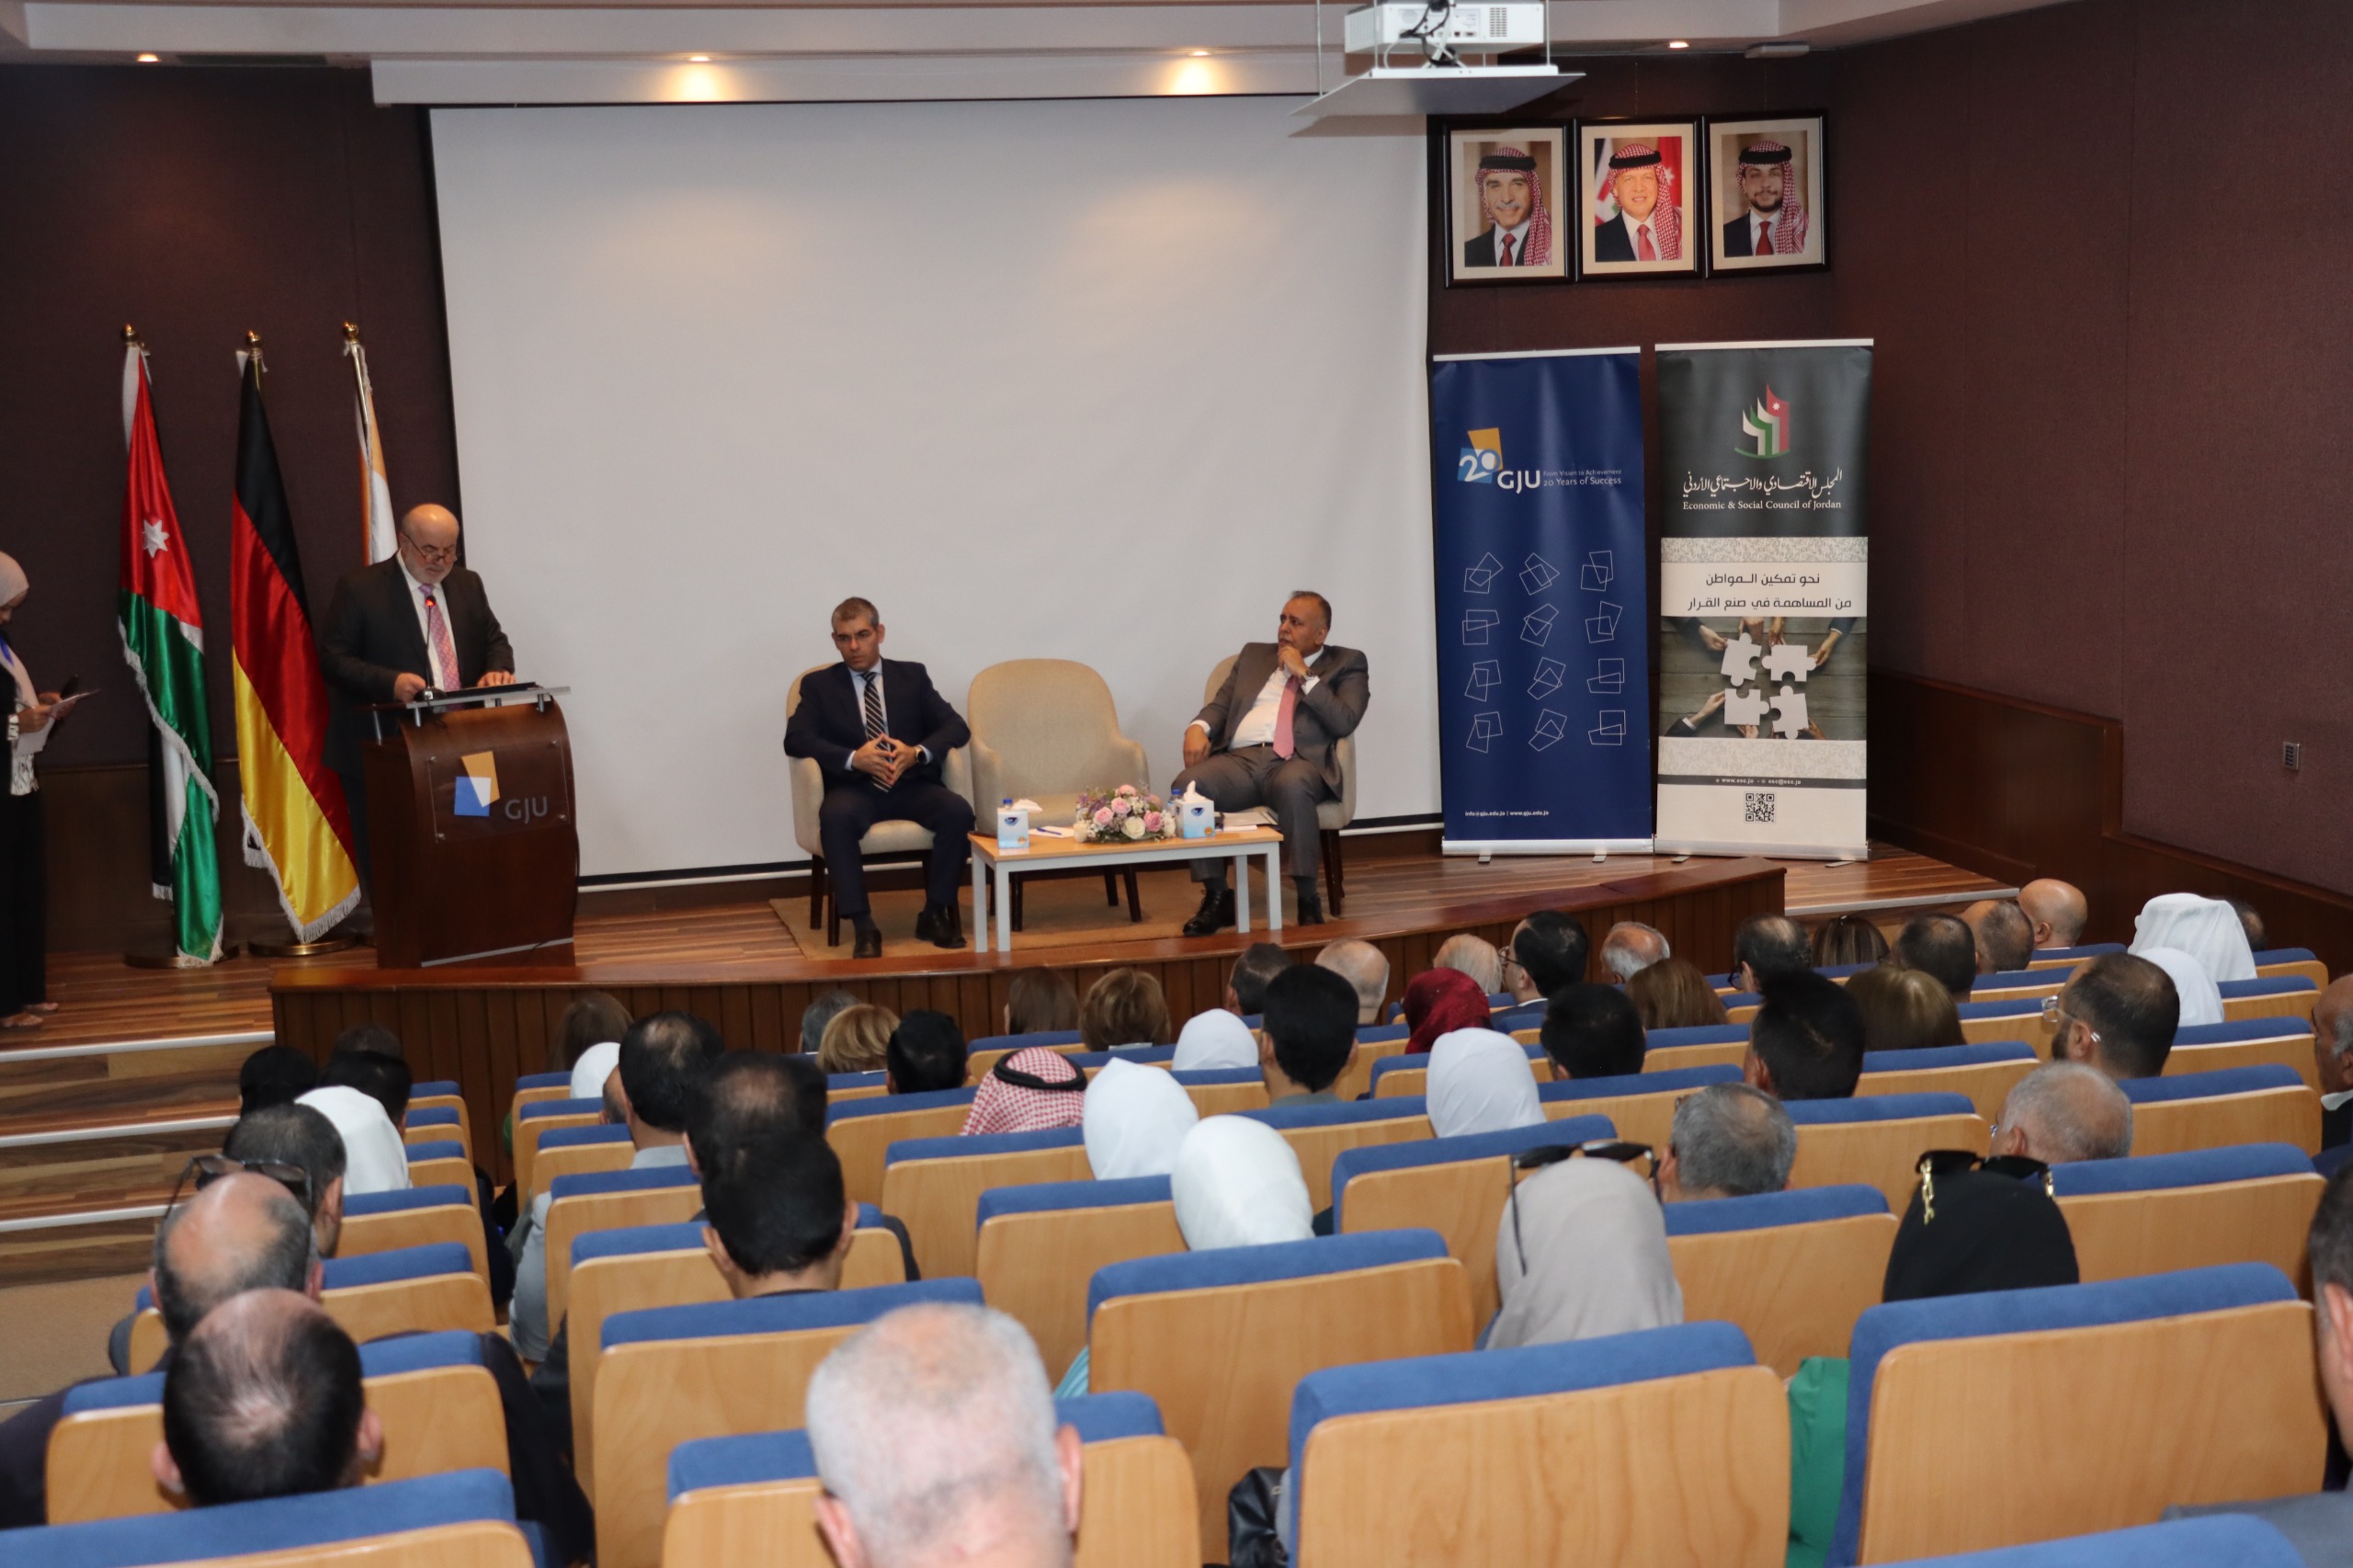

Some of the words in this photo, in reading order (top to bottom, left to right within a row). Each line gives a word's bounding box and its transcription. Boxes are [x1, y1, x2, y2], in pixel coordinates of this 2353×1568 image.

[1496, 470, 1541, 494] GJU
[1556, 478, 1578, 486] Years
[1579, 476, 1589, 485] of
[1589, 476, 1622, 485] Success
[1710, 474, 1763, 497] والاجتماعي
[1764, 471, 1817, 496] الاقتصادي
[1811, 466, 1843, 499] المجلس
[1683, 501, 1725, 510] Economic
[1727, 501, 1736, 509] &
[1737, 500, 1763, 509] Social
[1765, 500, 1800, 509] Council
[1802, 500, 1813, 509] of
[1813, 500, 1842, 511] Jordan
[1761, 573, 1796, 586] تمكين
[1799, 574, 1820, 586] نحو
[1688, 597, 1720, 611] القرار
[1723, 597, 1746, 611] صنع
[1751, 597, 1770, 610] في
[1773, 597, 1832, 608] المساهمة
[1835, 599, 1852, 610] من
[505, 796, 548, 824] GJU
